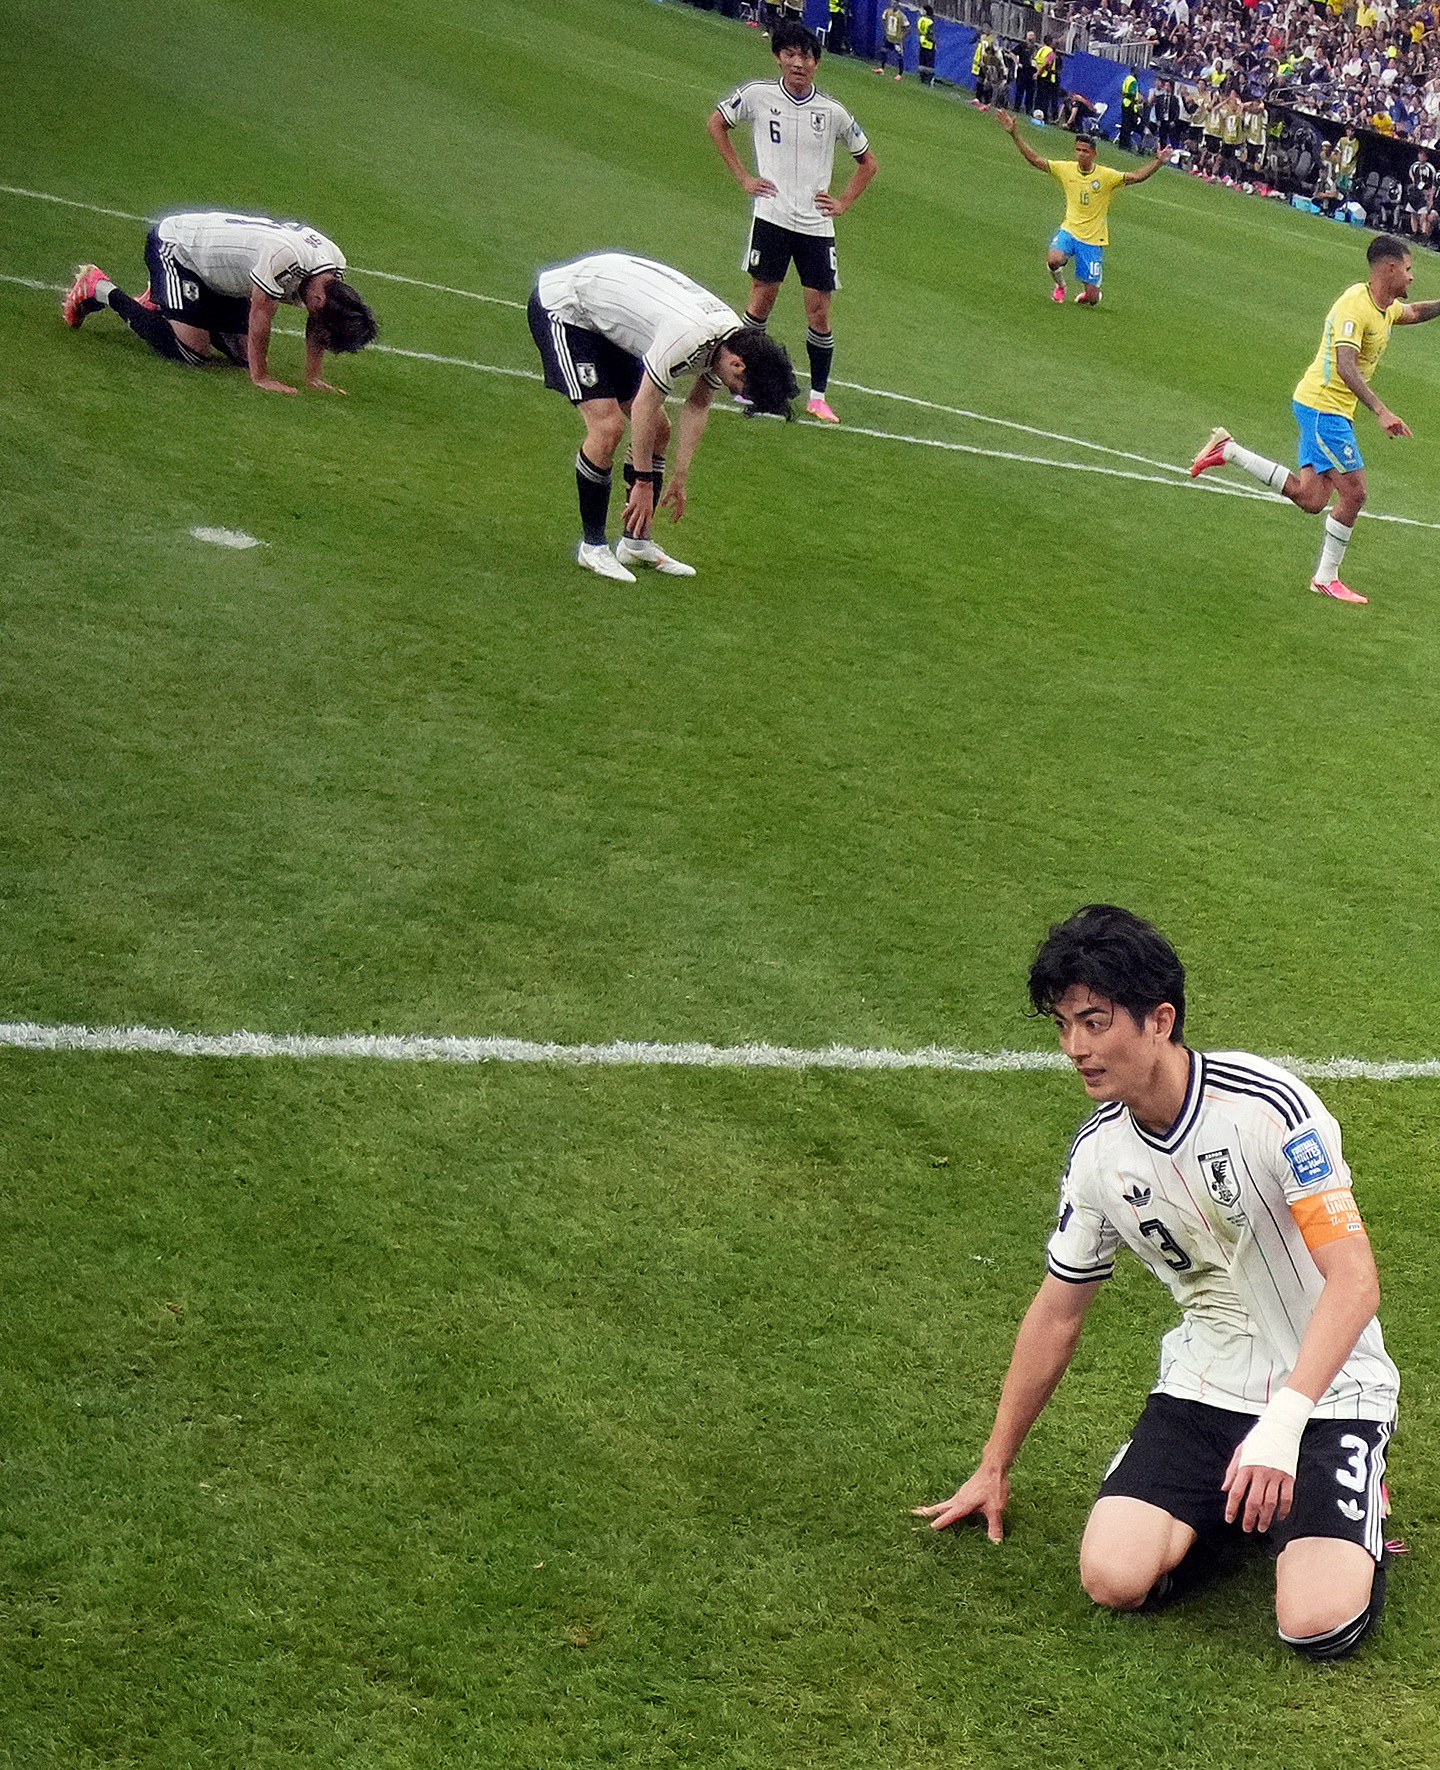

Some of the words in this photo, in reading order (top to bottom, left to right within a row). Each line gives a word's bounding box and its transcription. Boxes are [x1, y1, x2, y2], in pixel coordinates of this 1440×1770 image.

[769, 120, 781, 144] 6
[1139, 1218, 1192, 1271] 3
[1335, 1433, 1369, 1493] 3
